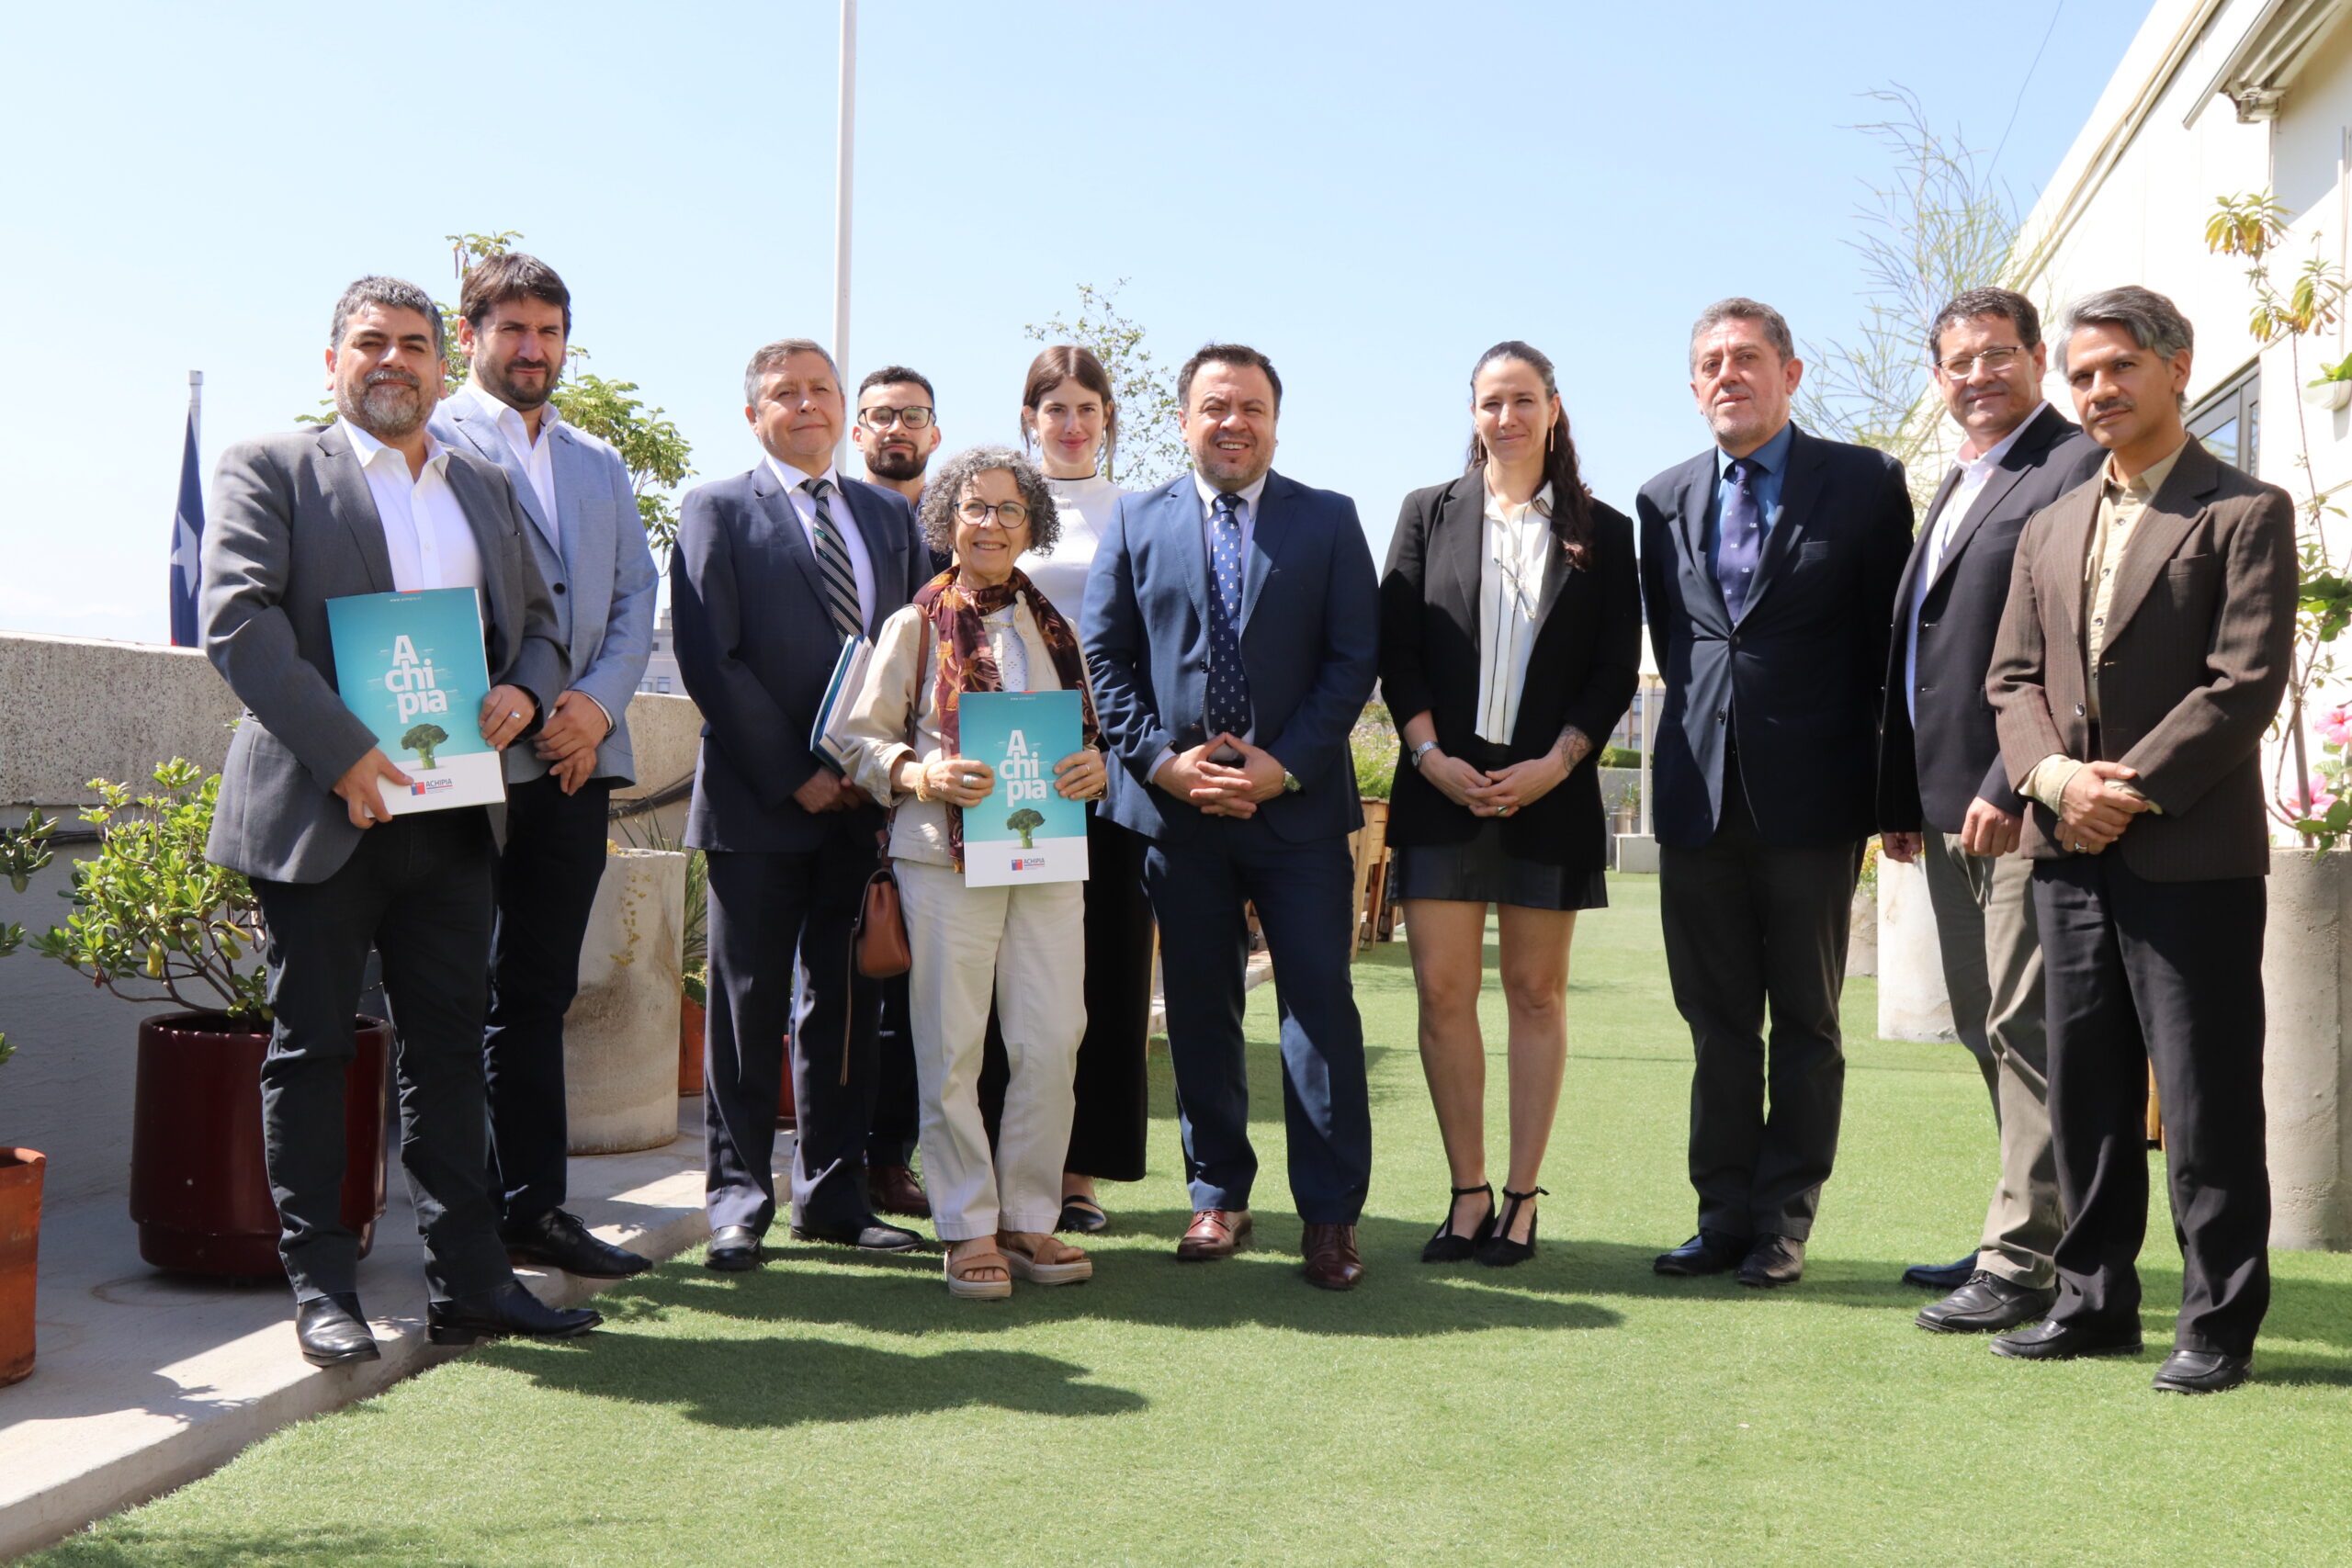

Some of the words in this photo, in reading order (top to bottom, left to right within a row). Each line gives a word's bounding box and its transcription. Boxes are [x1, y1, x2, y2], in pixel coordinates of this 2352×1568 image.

[392, 635, 420, 667] A
[385, 659, 435, 693] chi
[397, 689, 447, 724] pia
[1006, 729, 1028, 757] A
[999, 751, 1039, 780] chi
[425, 778, 452, 787] ACHIPIA
[1007, 779, 1047, 807] pia
